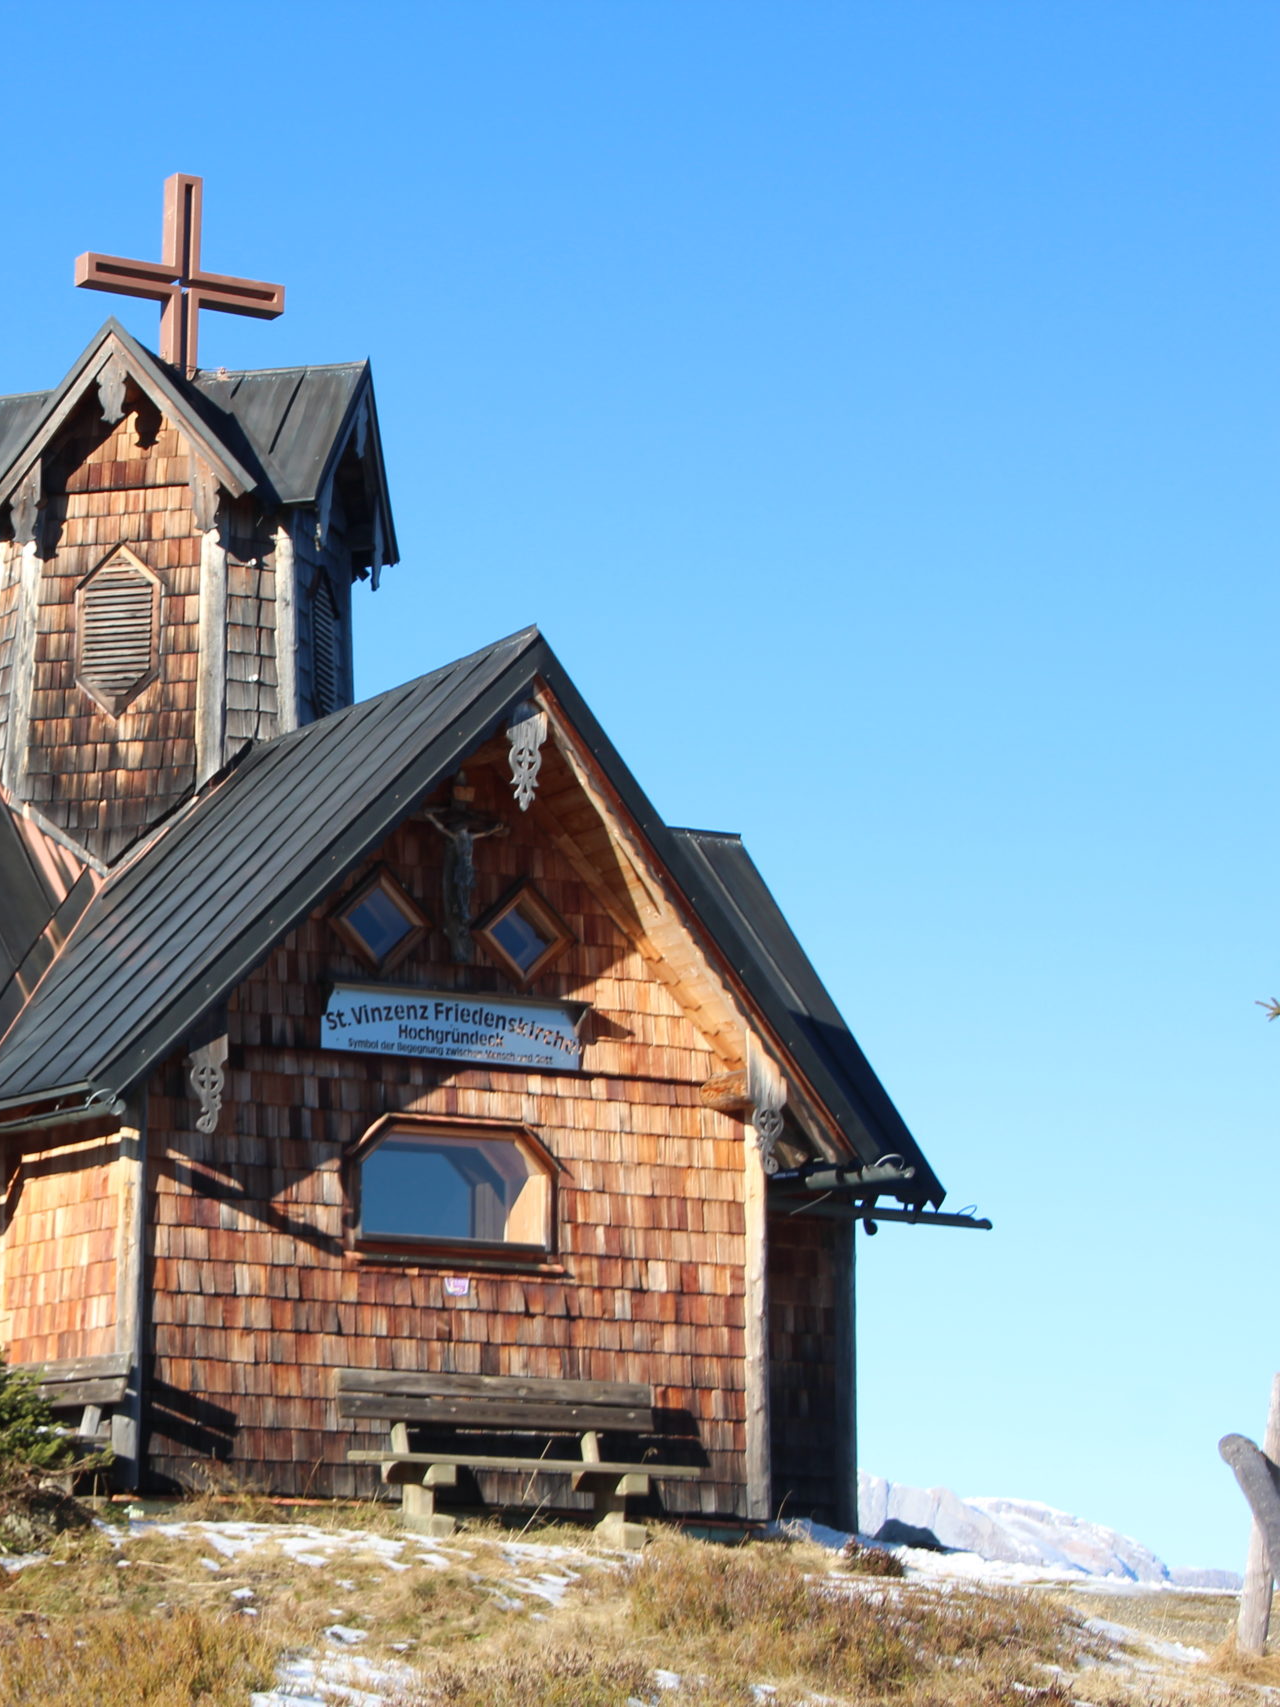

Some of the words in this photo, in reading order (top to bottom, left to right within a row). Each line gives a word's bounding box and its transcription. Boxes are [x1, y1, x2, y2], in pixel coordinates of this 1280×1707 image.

[325, 1009, 351, 1030] St.
[351, 1004, 428, 1025] Vinzenz
[348, 1038, 379, 1049] Symbol
[381, 1040, 395, 1050] der
[397, 1042, 444, 1056] Begegnung
[398, 1024, 505, 1047] Hochgründeck
